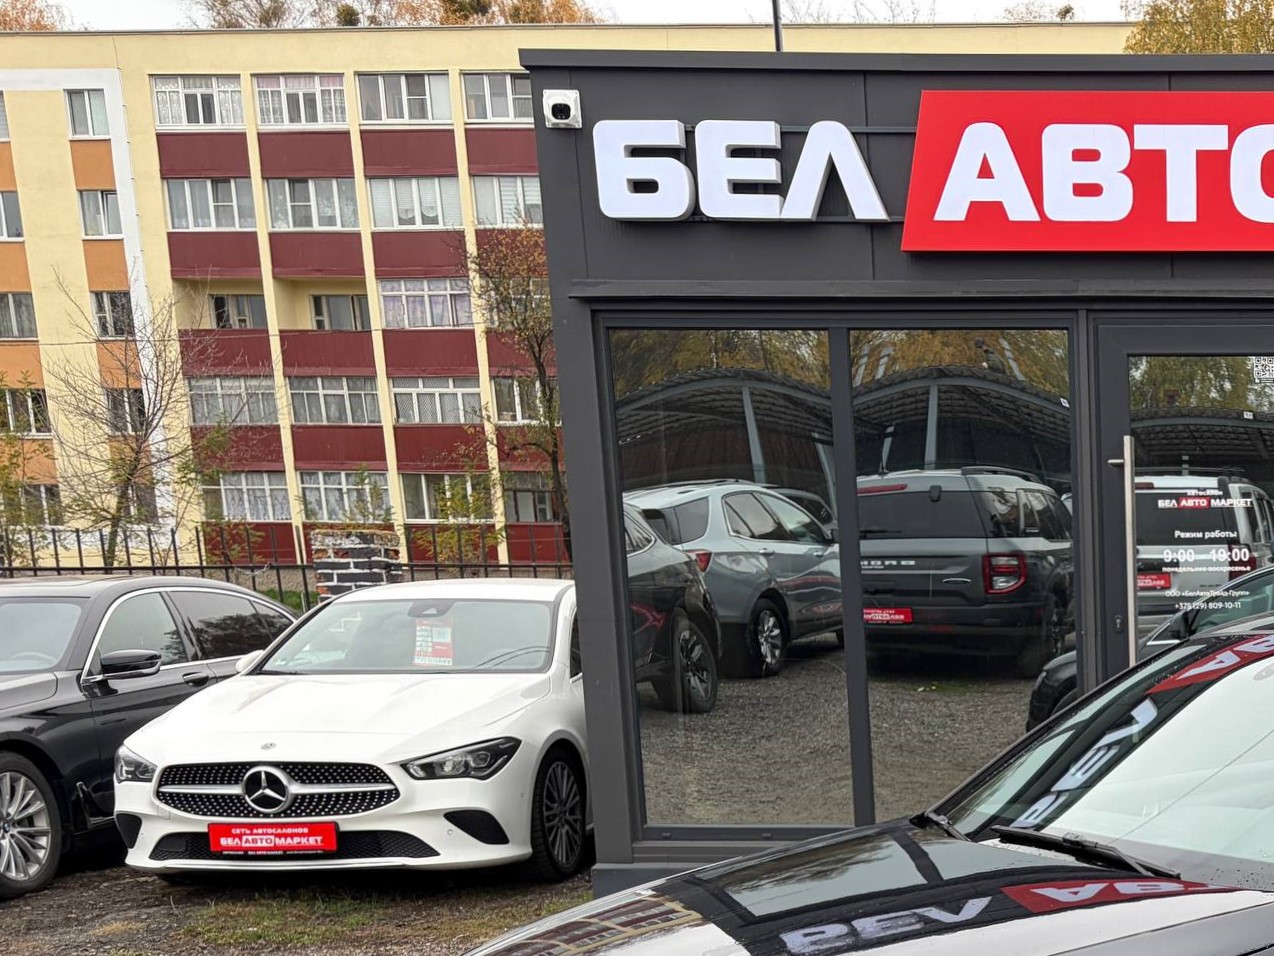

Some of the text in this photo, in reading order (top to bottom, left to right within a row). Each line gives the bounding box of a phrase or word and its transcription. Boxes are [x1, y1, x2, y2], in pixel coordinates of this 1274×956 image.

[592, 119, 890, 222] БЕЛ
[1157, 498, 1253, 508] БЕЛ АВТО МАРКЕТ
[1174, 530, 1203, 538] Режим
[1163, 548, 1249, 562] 9:00 19:00
[220, 835, 323, 845] БЕЛ АВТО МАРКЕТ
